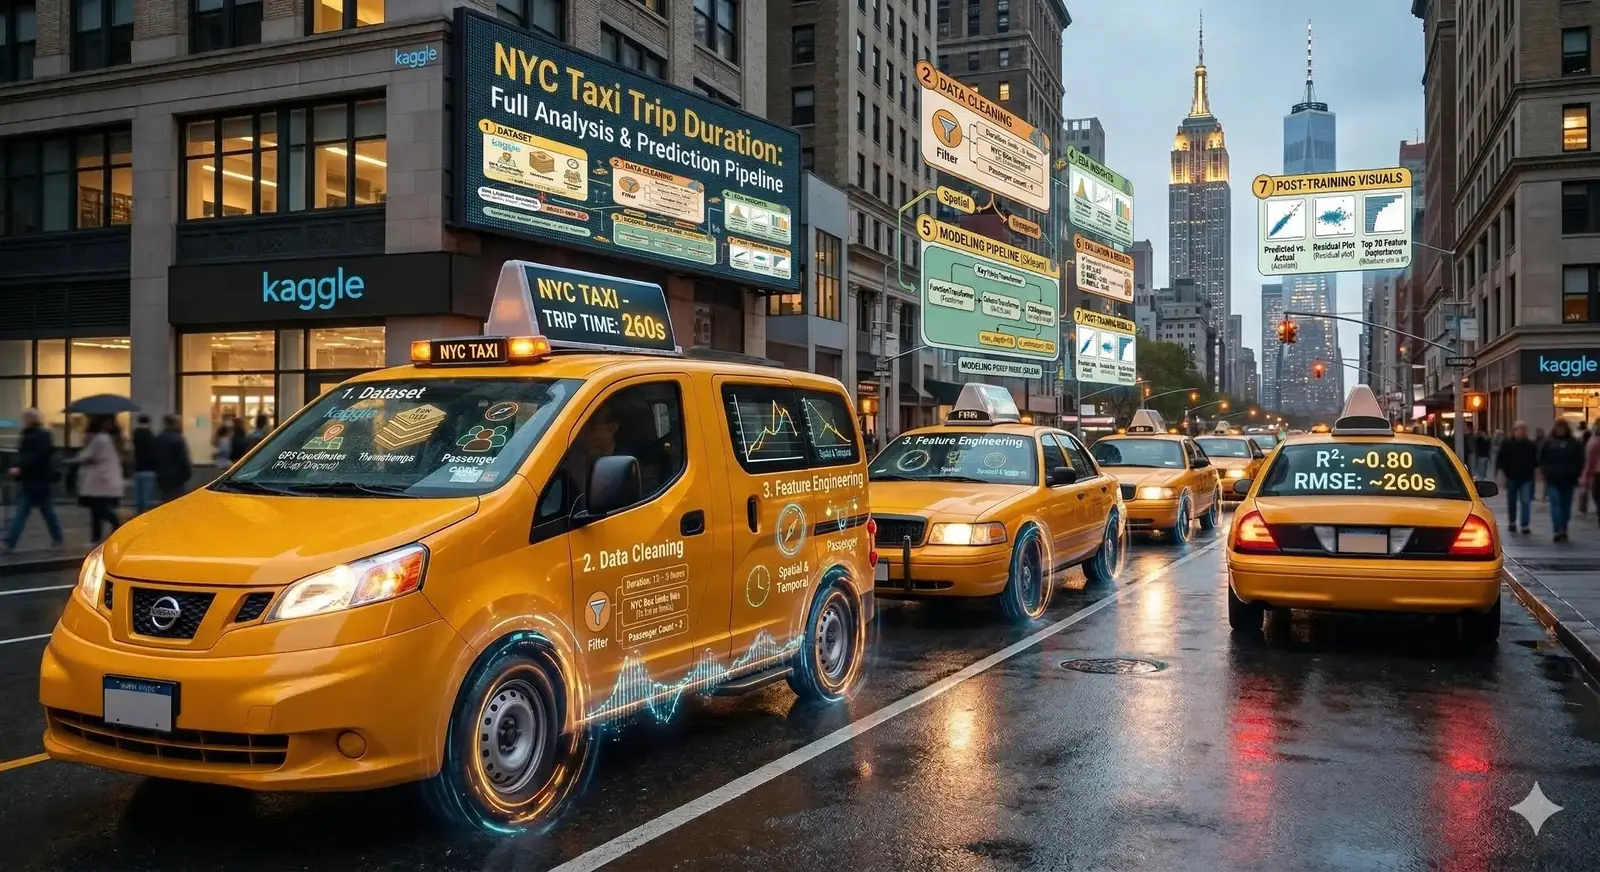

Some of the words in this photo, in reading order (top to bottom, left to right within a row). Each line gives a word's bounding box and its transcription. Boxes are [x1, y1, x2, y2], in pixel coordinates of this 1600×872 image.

[395, 45, 437, 68] kaggle
[494, 42, 559, 93] NYC
[566, 67, 621, 114] Taxi
[628, 89, 677, 136] Trip
[684, 108, 783, 166] Duration:
[922, 66, 931, 83] 2
[940, 78, 965, 103] DATA
[968, 94, 1012, 128] CLEANING
[484, 122, 489, 131] 1
[497, 126, 533, 143] DATASET
[491, 86, 528, 118] Full
[534, 105, 614, 142] Analysis
[619, 127, 632, 149] &
[637, 132, 720, 174] Prediction
[725, 159, 783, 193] Pipeline
[937, 147, 958, 165] Filter
[1069, 149, 1074, 159] 4
[1079, 155, 1090, 169] EDA
[625, 162, 642, 173] DATA
[642, 166, 674, 182] CLEANING
[1259, 180, 1267, 193] 7
[1276, 176, 1356, 192] POST-TRAINING
[1359, 172, 1403, 185] VISUALS
[923, 220, 931, 236] 5
[940, 226, 985, 252] MODELING
[986, 243, 1020, 263] PIPELINE
[1076, 238, 1081, 249] 6
[1264, 245, 1295, 254] Predicted
[1296, 245, 1306, 253] vs.
[1313, 243, 1341, 252] Residual
[1341, 241, 1355, 249] Plot
[1361, 241, 1373, 250] Top
[1384, 239, 1407, 247] Feature
[1274, 253, 1295, 262] Actual
[263, 266, 365, 310] kaggle
[537, 277, 576, 303] NYC
[578, 283, 619, 309] TAXI
[542, 309, 577, 329] TRIP
[580, 313, 620, 334] TIME:
[622, 313, 666, 340] 260s
[440, 344, 466, 359] NYC
[469, 343, 498, 358] TAXI
[961, 361, 992, 371] MODELING
[1539, 355, 1597, 377] kaggle
[341, 387, 353, 398] 1.
[359, 386, 426, 400] Dataset
[902, 437, 912, 445] 3.
[916, 436, 956, 446] Feature
[958, 436, 1023, 448] Engineering
[278, 451, 298, 460] GPS
[441, 454, 497, 465] Passenger
[1352, 451, 1413, 468] ~0.80
[763, 481, 773, 498] 3.
[776, 478, 811, 496] Feature
[813, 471, 863, 493] Engineering
[1294, 473, 1362, 490] RMSE:
[1369, 473, 1436, 491] ~260s
[826, 537, 858, 553] Passenger
[583, 552, 596, 572] 2.
[600, 550, 629, 570] Data
[632, 539, 684, 567] Cleaning
[778, 563, 802, 578] Spatial
[802, 560, 809, 572] &
[776, 576, 809, 594] Temporal
[630, 599, 643, 610] NYC
[628, 628, 657, 642] Passenger
[588, 637, 608, 652] Filter
